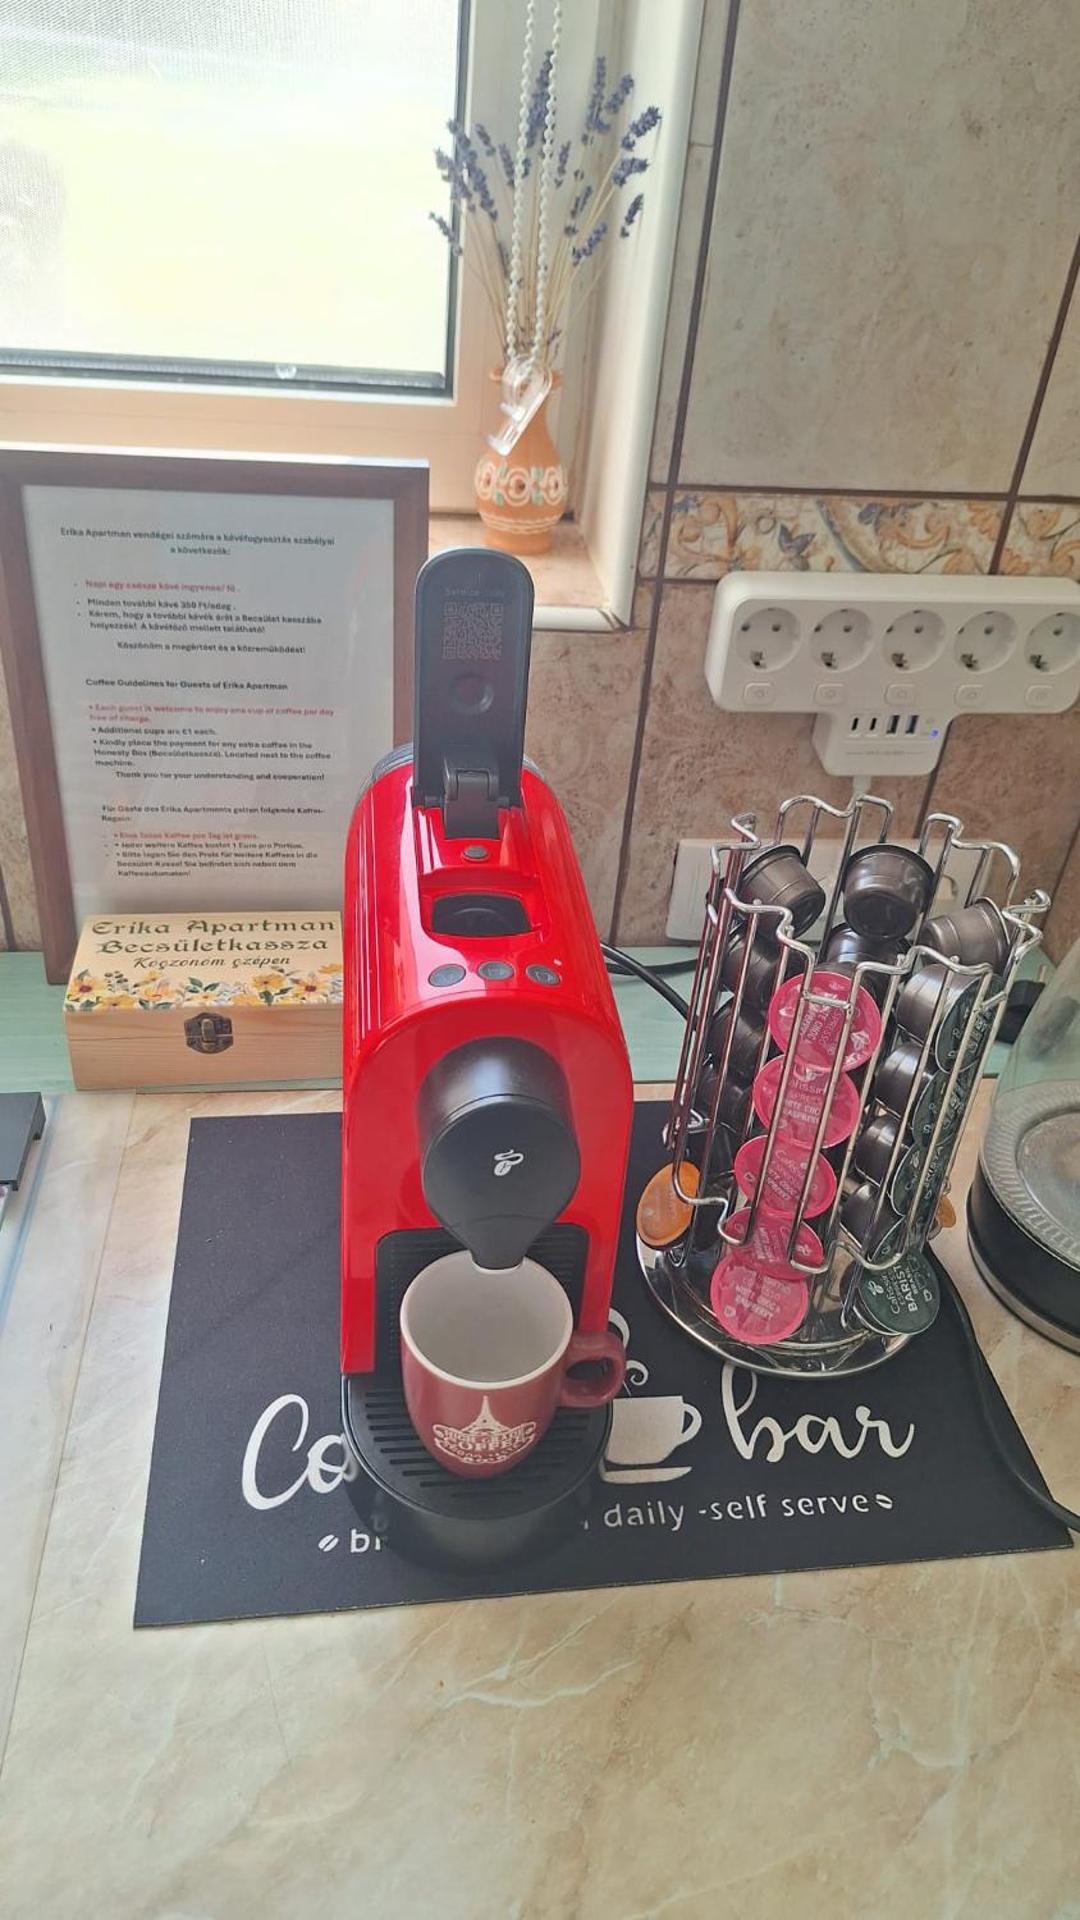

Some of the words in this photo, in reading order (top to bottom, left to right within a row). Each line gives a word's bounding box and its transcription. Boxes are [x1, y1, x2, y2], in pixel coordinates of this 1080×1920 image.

[59, 526, 84, 536] Erika
[85, 527, 131, 540] Apartman
[87, 597, 120, 608] Minden
[122, 610, 144, 621] hogy
[85, 677, 115, 687] Coffee
[116, 678, 164, 688] Guidelines
[165, 679, 178, 688] for
[180, 679, 210, 689] Guests
[212, 680, 221, 689] of
[222, 680, 244, 689] Erika
[246, 680, 288, 692] Apartman
[275, 706, 302, 716] coffee
[97, 725, 142, 735] Additional
[143, 728, 165, 737] cups
[98, 737, 126, 749] Kindly
[128, 738, 151, 749] place
[153, 738, 167, 747] the
[169, 739, 206, 750] payment
[207, 739, 220, 748] for
[222, 741, 236, 751] any
[260, 740, 287, 750] coffee
[289, 741, 297, 750] in
[298, 741, 312, 750] the
[224, 749, 258, 759] Located
[259, 750, 278, 759] next
[279, 750, 288, 759] to
[289, 751, 303, 760] the
[304, 751, 331, 760] coffee
[116, 769, 141, 779] Thank
[143, 772, 159, 781] you
[159, 770, 172, 779] for
[173, 772, 192, 781] your
[255, 771, 271, 780] and
[160, 805, 182, 813] Erika
[92, 921, 170, 935] Erika
[187, 920, 335, 935] Apartman
[97, 938, 329, 954] Becsületkassza
[892, 1265, 918, 1312] BARIST
[721, 1361, 915, 1463] bar
[603, 1501, 684, 1531] daily
[783, 1493, 869, 1517] serve
